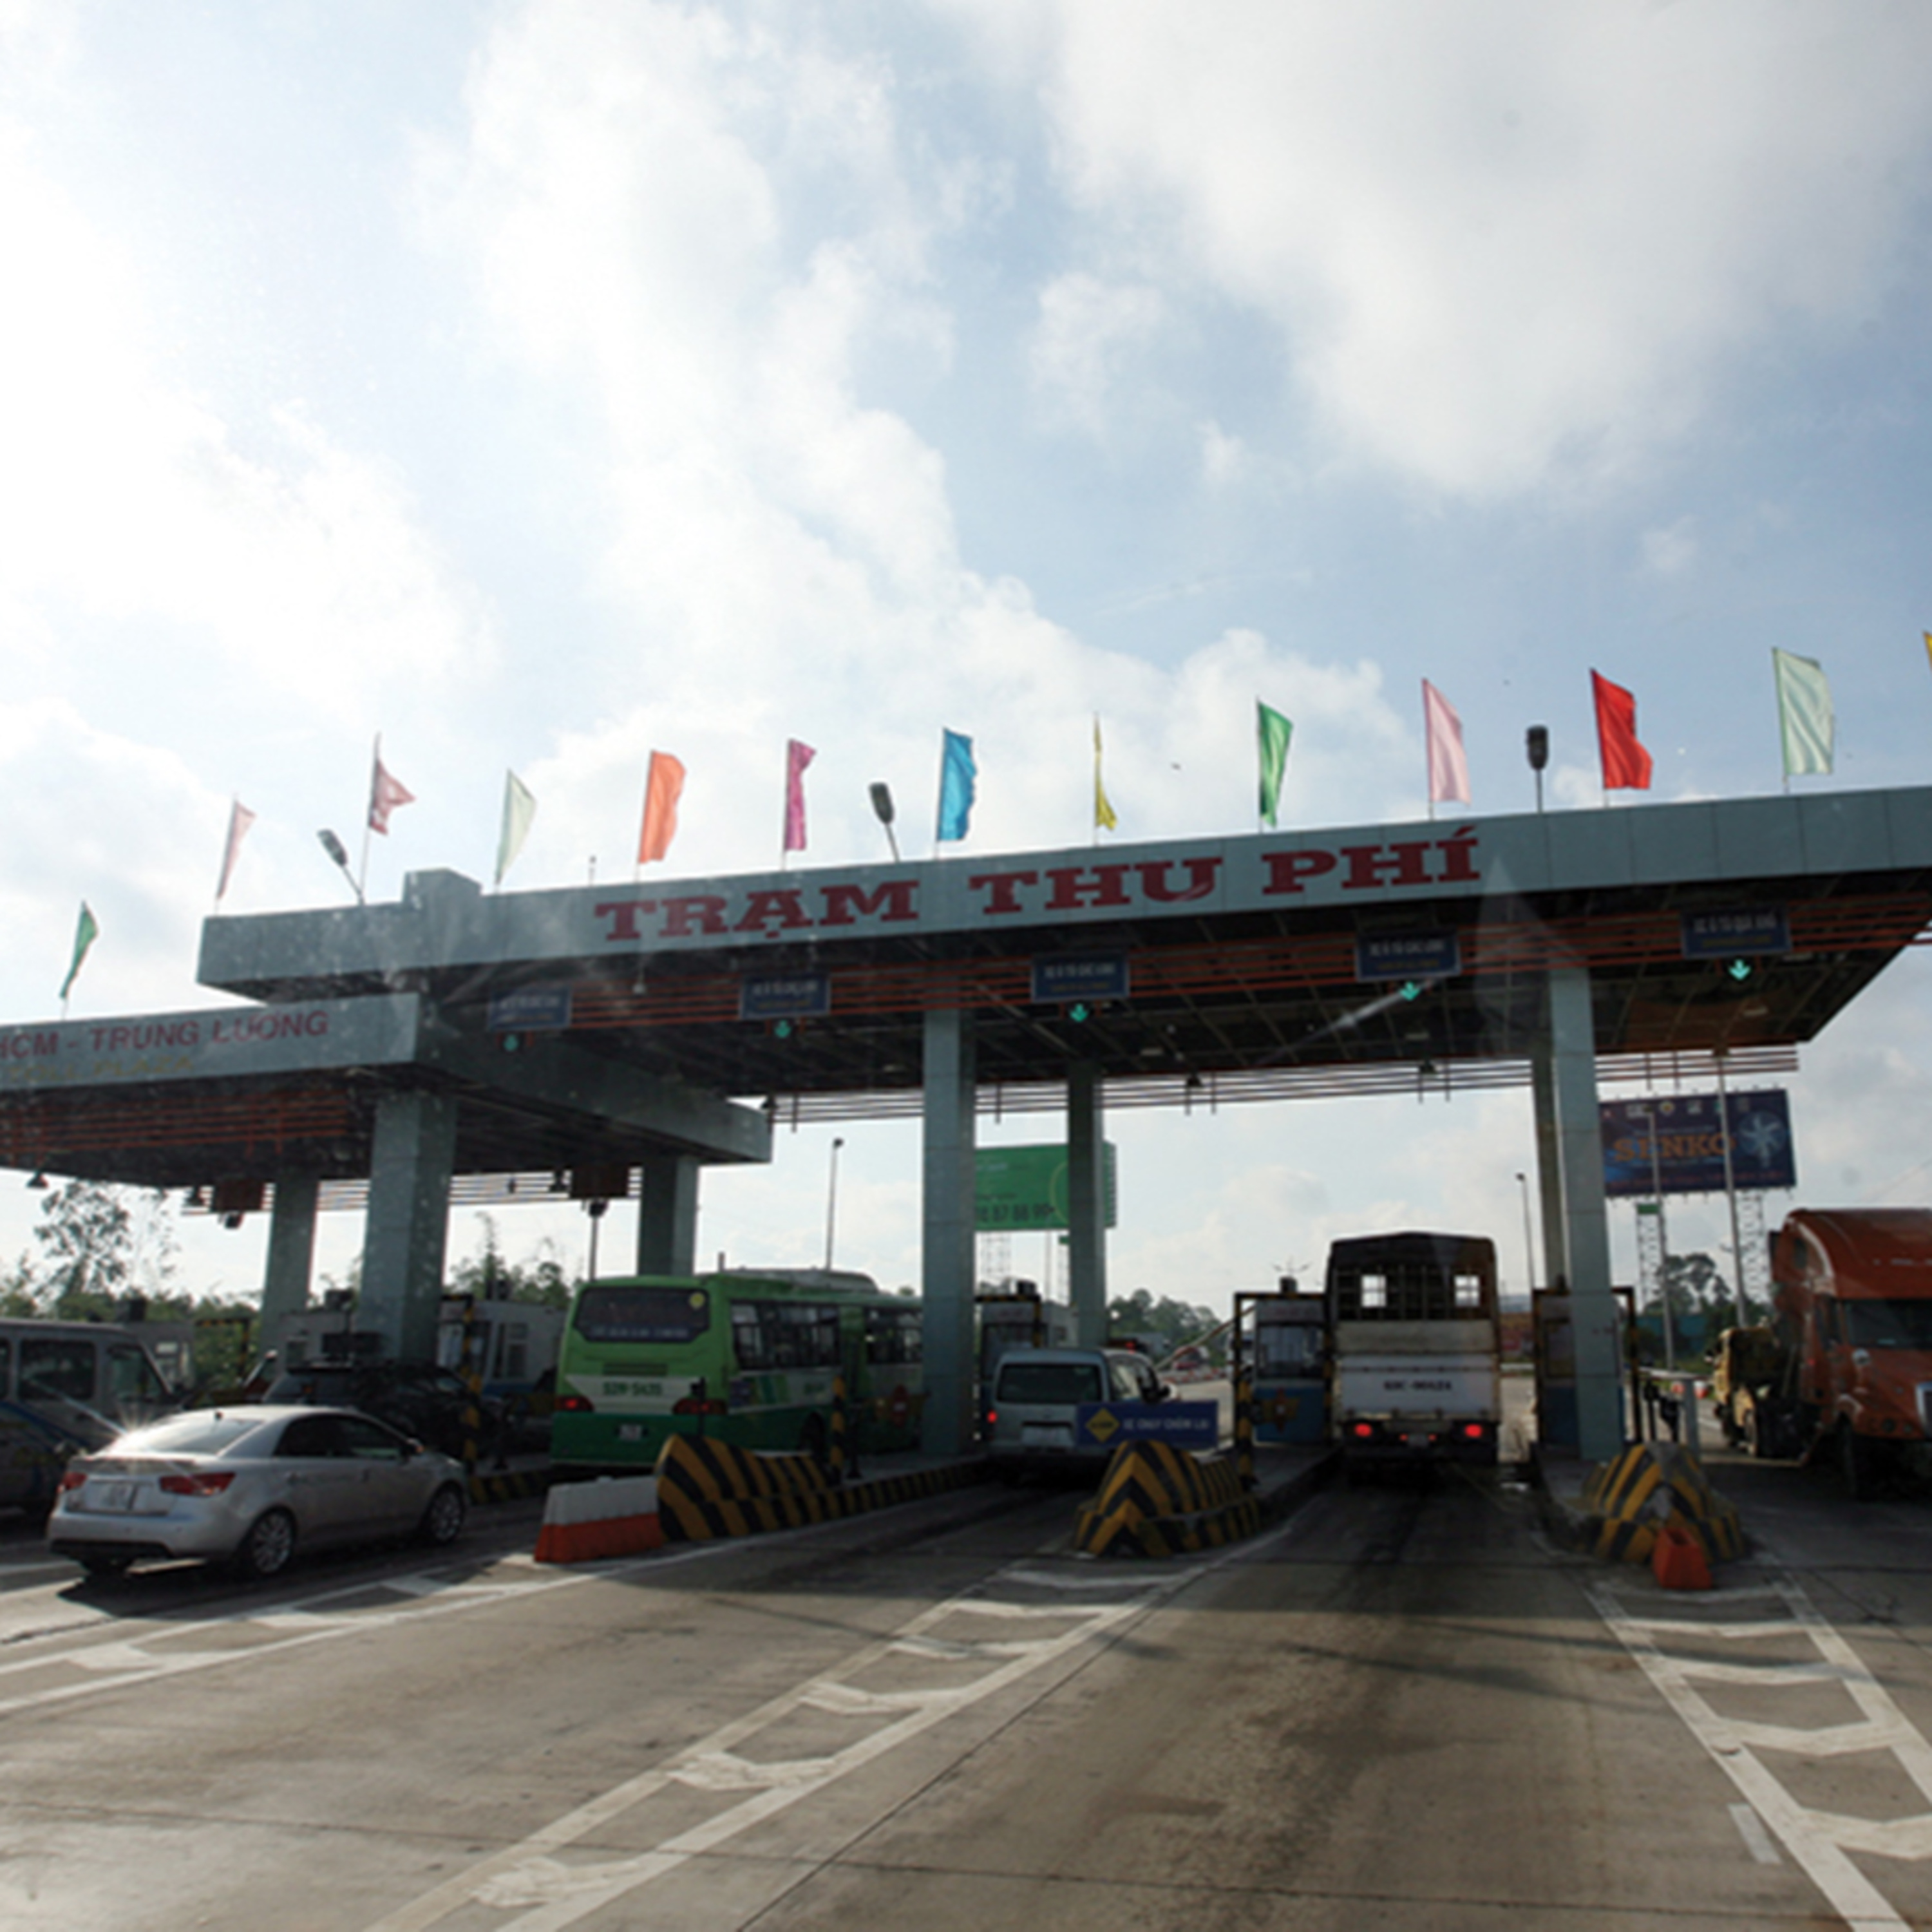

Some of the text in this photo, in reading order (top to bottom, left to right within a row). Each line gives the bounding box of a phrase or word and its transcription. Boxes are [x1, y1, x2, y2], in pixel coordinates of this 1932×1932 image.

[594, 826, 1481, 941] TRẠM THU PHÍ
[90, 1021, 200, 1051] TRUNG
[93, 1056, 191, 1076] PLAZA
